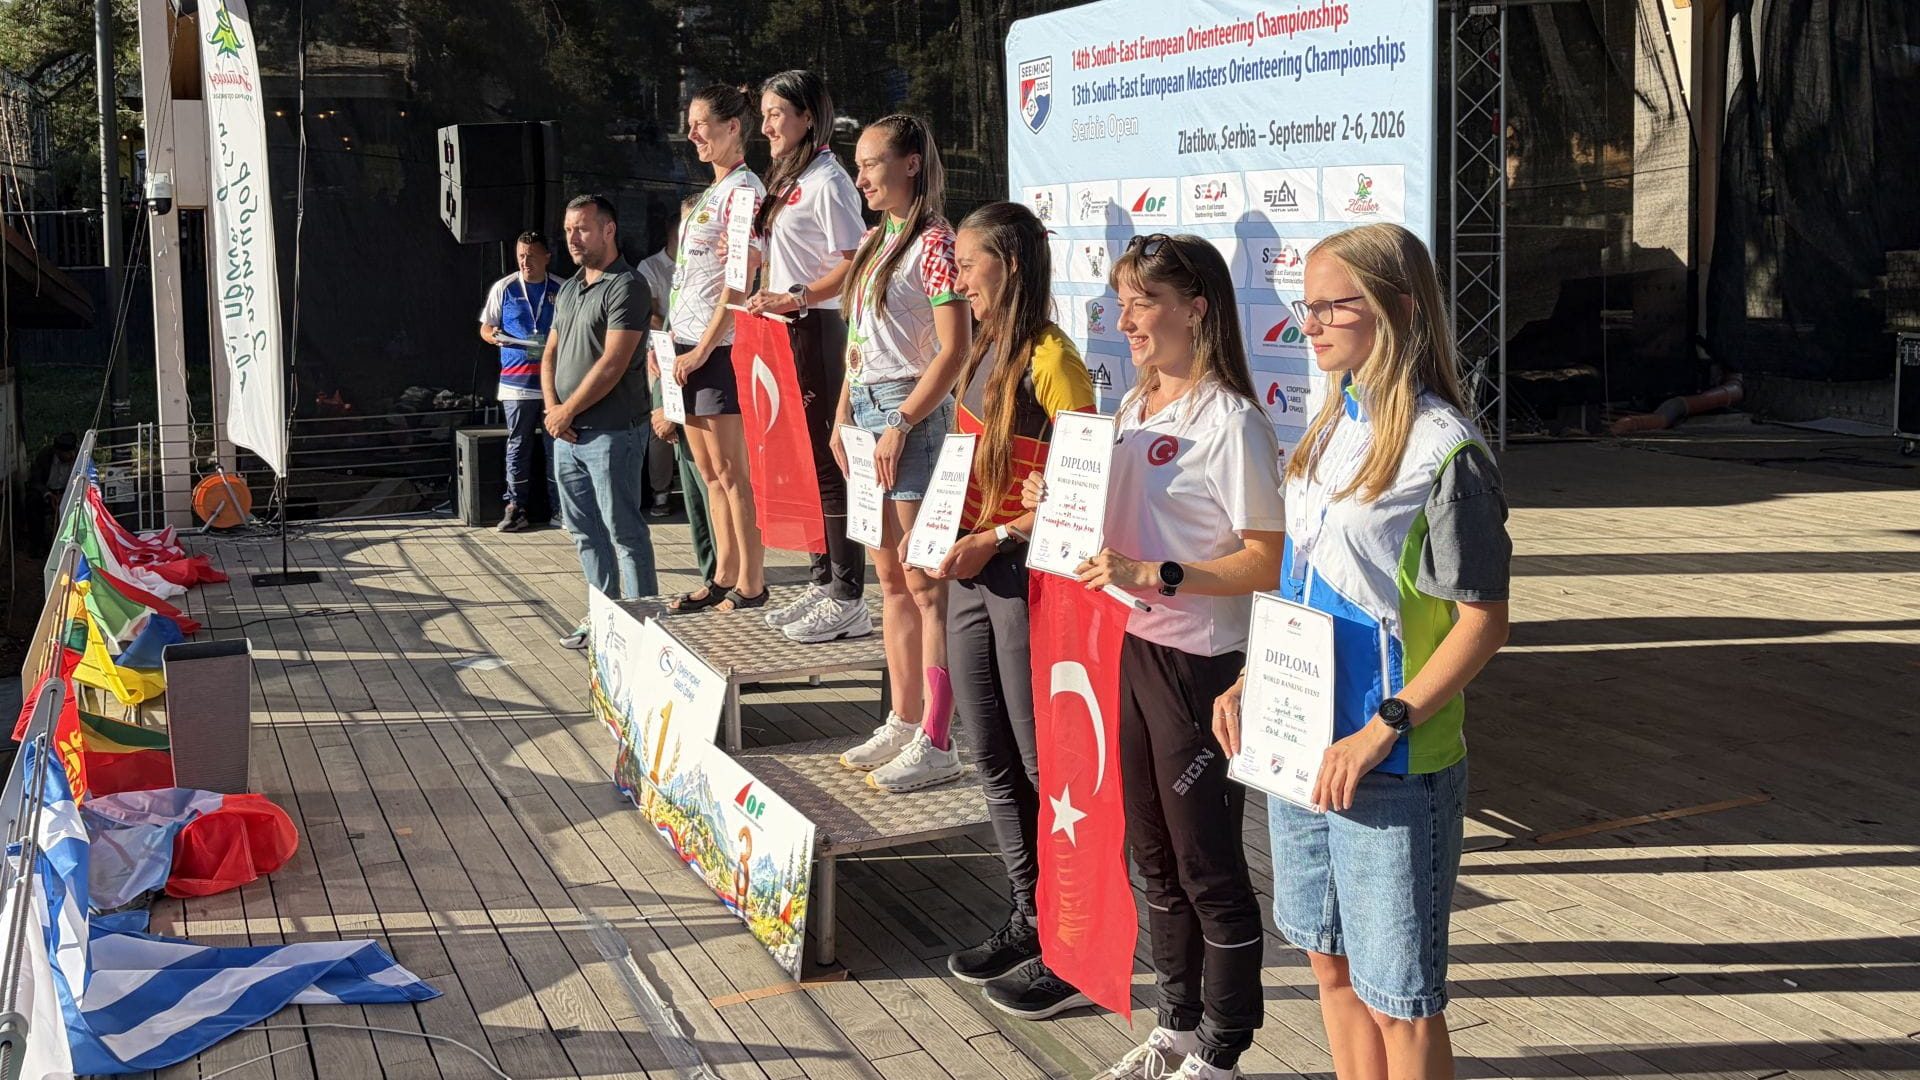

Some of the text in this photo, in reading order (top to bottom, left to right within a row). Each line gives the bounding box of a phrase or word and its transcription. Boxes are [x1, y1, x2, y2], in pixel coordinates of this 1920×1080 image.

[1072, 0, 1349, 71] 14th South-East European Orienteering Championships
[1072, 35, 1406, 106] 13th South-East European Masters Orienteering Championships
[1072, 113, 1139, 143] Serbia Open
[1178, 128, 1219, 155] Zlatibor,
[1221, 122, 1256, 150] Serbia
[1269, 115, 1336, 151] September
[1342, 113, 1368, 144] 2-6,
[1371, 110, 1405, 138] 2026
[1060, 455, 1102, 473] DIPLOMA
[1265, 648, 1320, 678] DIPLOMA
